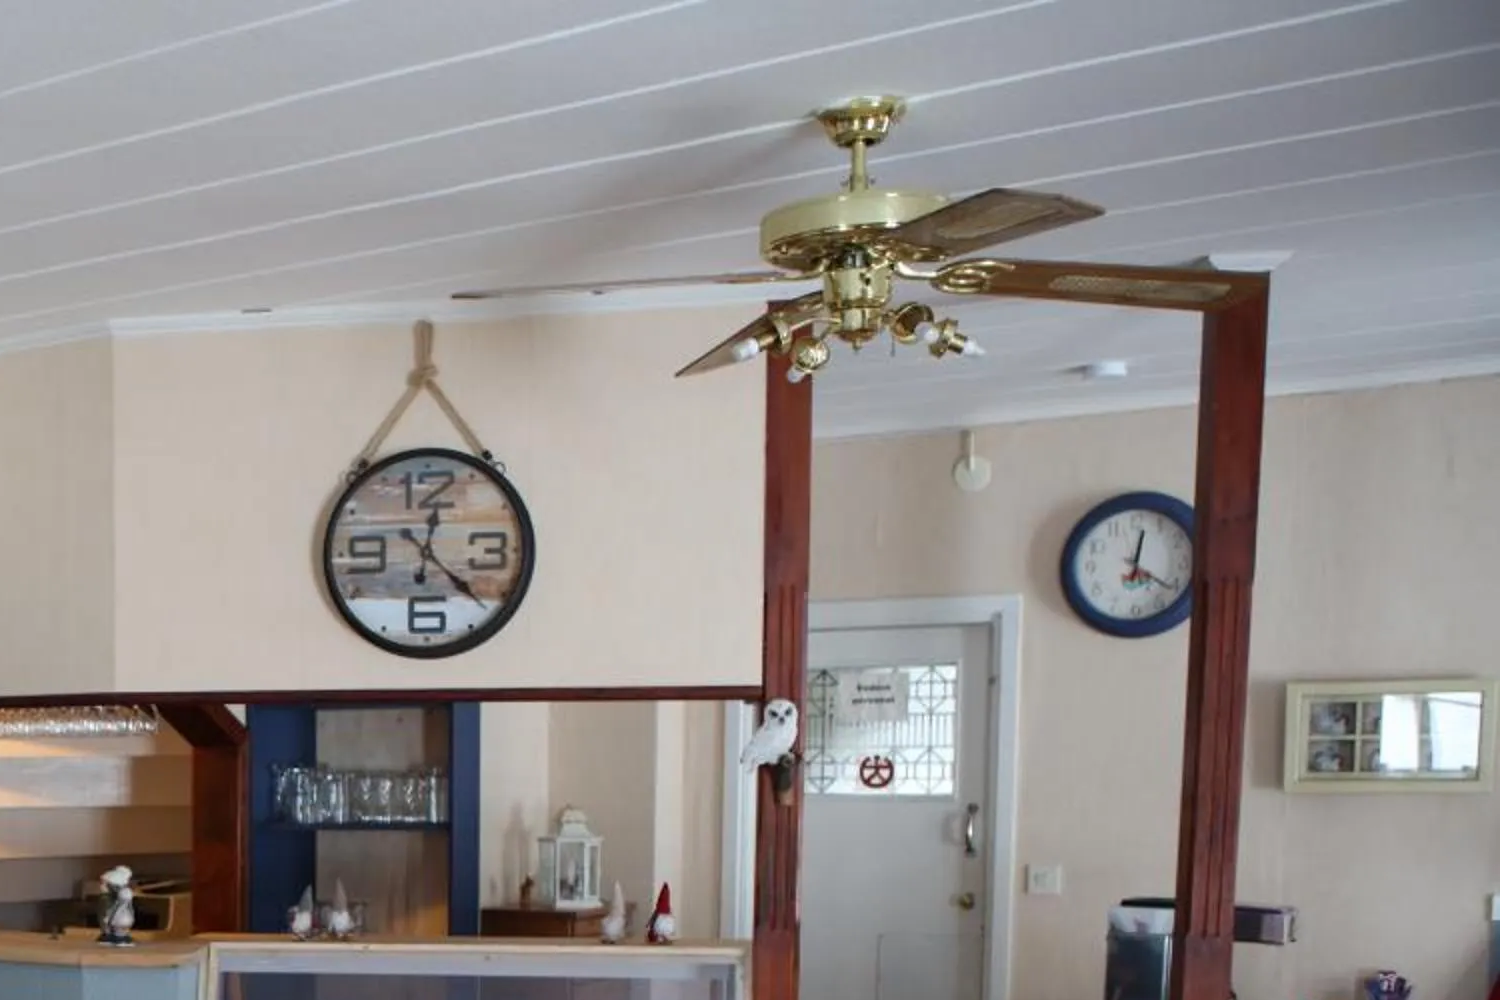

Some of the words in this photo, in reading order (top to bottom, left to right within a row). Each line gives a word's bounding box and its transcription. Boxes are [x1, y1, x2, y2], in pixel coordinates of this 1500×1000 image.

[401, 470, 455, 510] 12
[347, 535, 386, 574] 9
[468, 532, 507, 570] 3
[408, 595, 447, 634] 6
